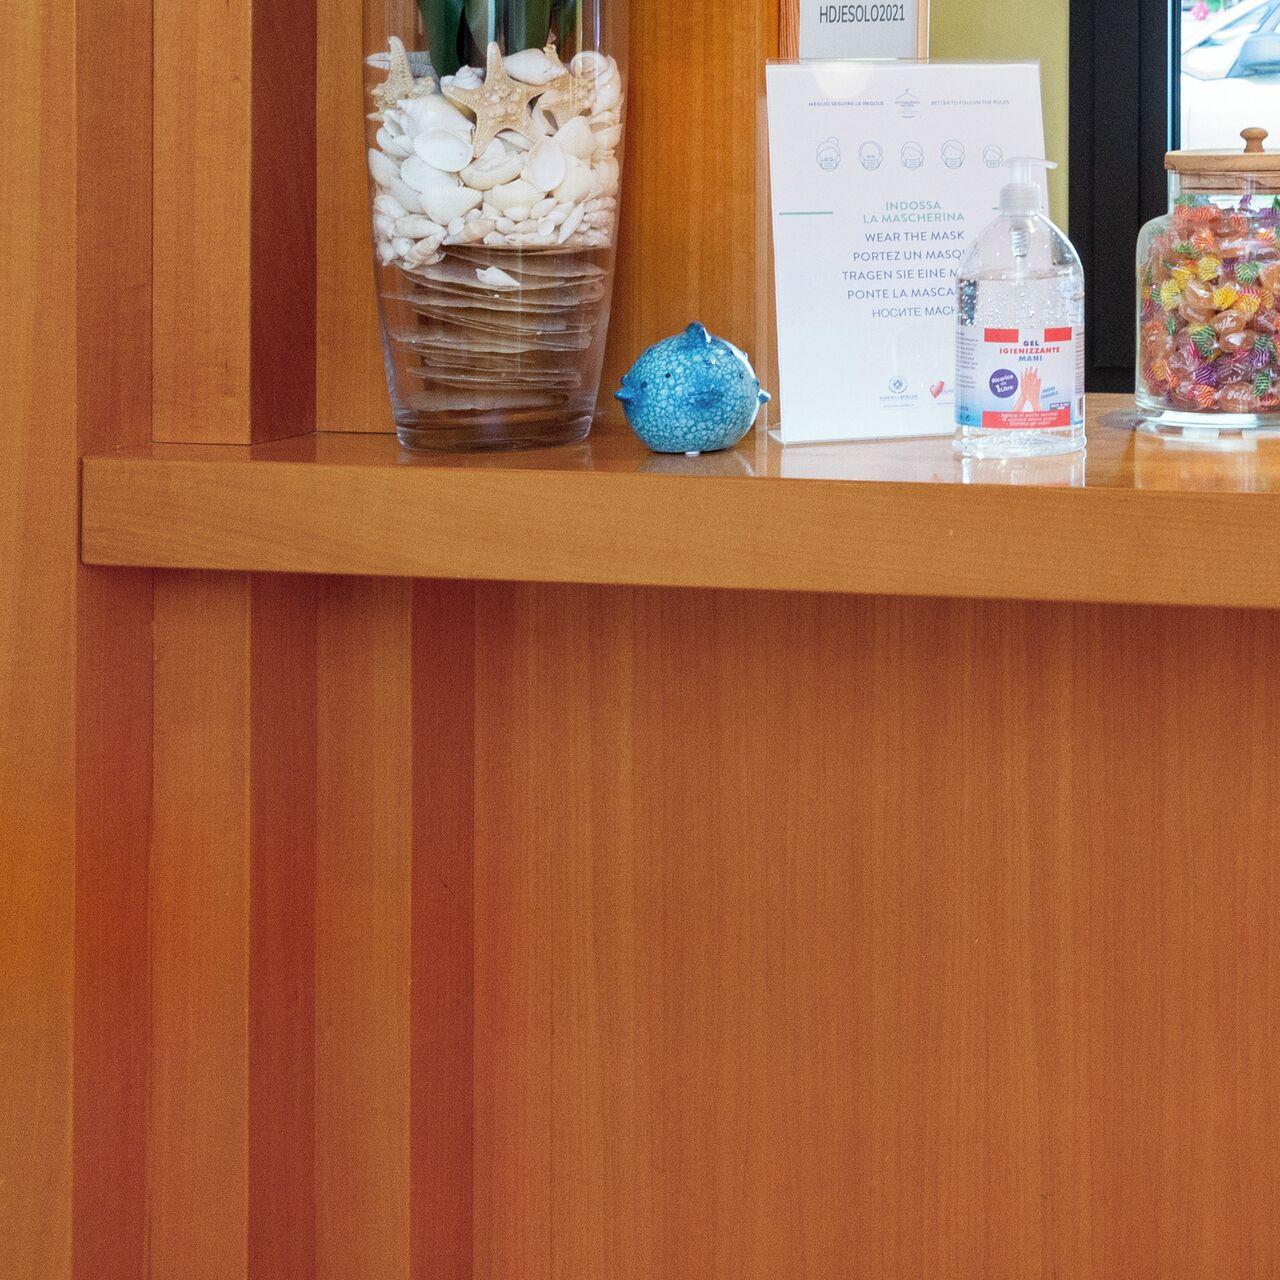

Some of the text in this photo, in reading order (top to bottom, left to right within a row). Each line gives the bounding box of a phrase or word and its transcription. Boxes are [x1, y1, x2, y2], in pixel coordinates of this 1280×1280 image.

[819, 3, 905, 23] HDJESOLO2021
[885, 200, 942, 211] INDOSSA
[863, 211, 965, 224] LA MASCHERINA
[865, 230, 965, 242] WEAR THE MASK
[853, 252, 901, 262] PORTEZ
[904, 251, 922, 261] UN
[842, 270, 892, 281] TRAGEN
[896, 269, 915, 280] SIE
[917, 268, 945, 279] EINE
[847, 287, 956, 300] PONTE LA MASCA
[999, 347, 1060, 355] IGIENIZZANTE
